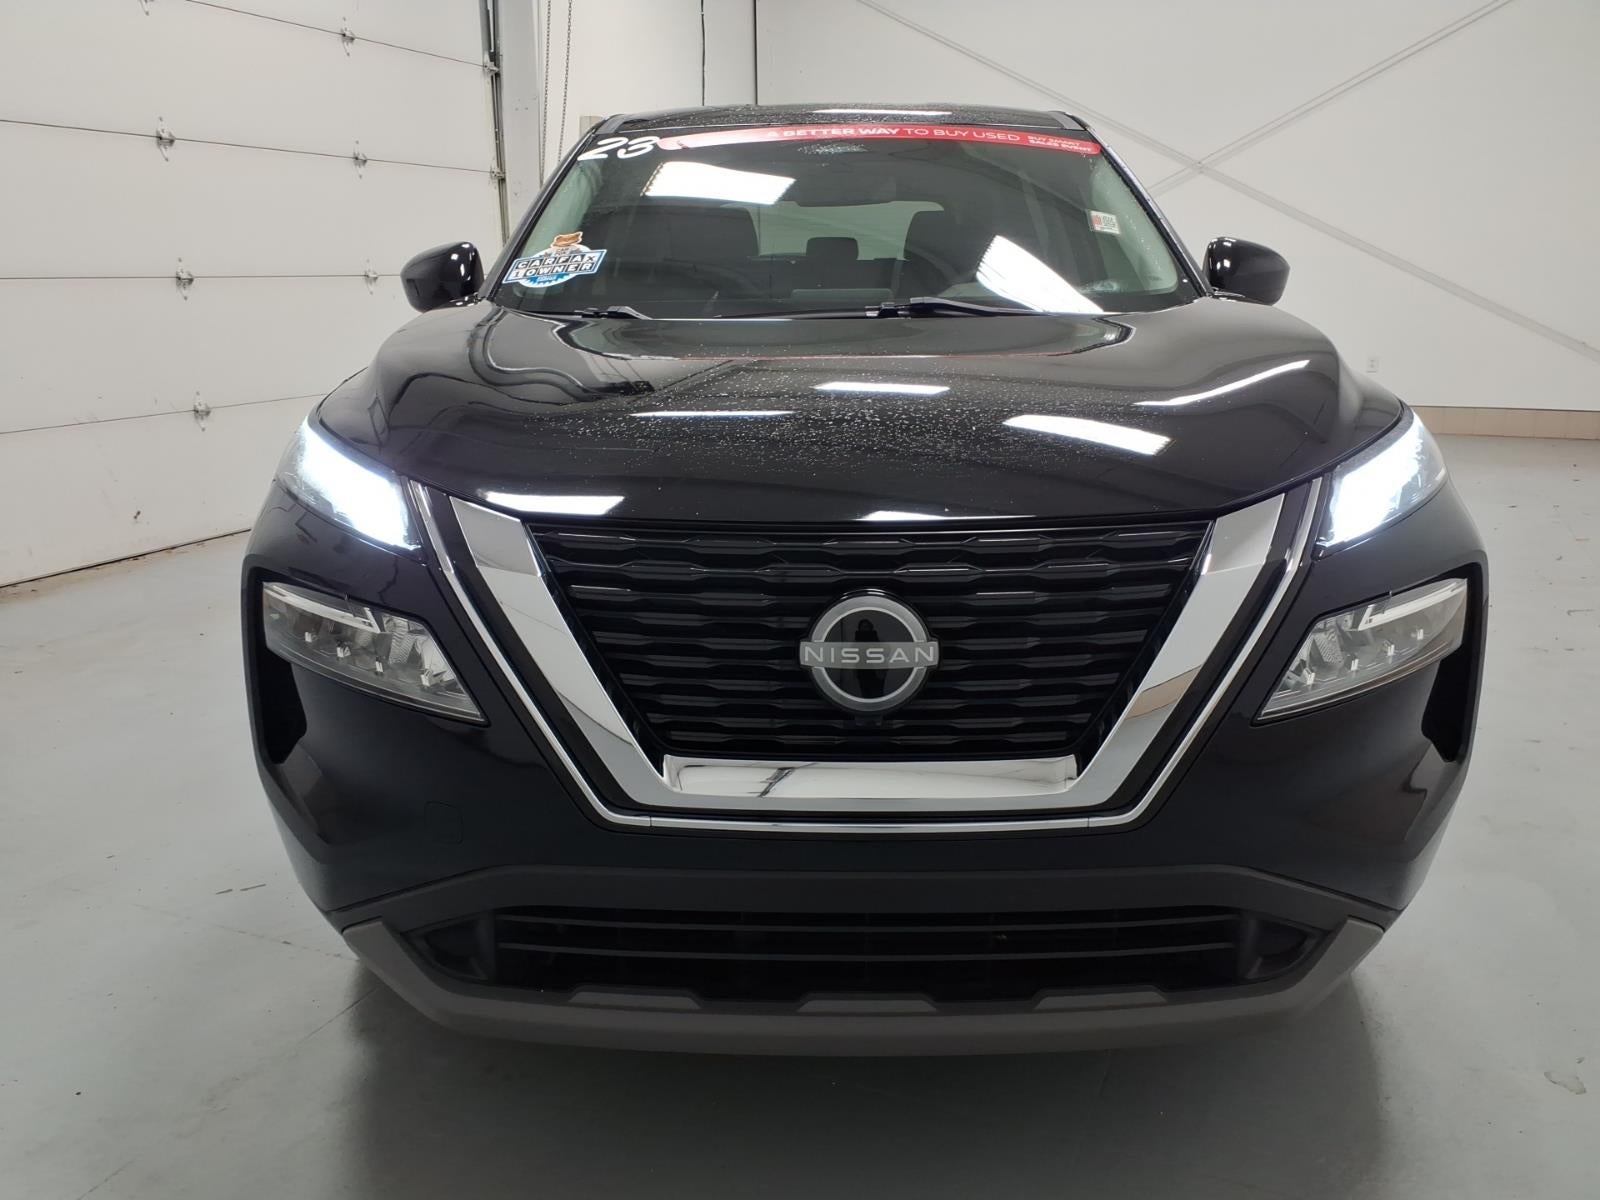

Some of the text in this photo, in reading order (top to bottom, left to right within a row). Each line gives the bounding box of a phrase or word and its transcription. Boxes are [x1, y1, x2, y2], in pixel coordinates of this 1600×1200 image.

[783, 128, 855, 137] BETTER
[859, 127, 900, 135] WAY
[903, 128, 929, 136] TO
[933, 129, 969, 137] BUY
[973, 131, 1020, 141] USED
[577, 136, 660, 161] 23
[517, 255, 596, 268] CARFAX
[525, 263, 593, 276] OWNER
[804, 646, 934, 664] NISSAN
